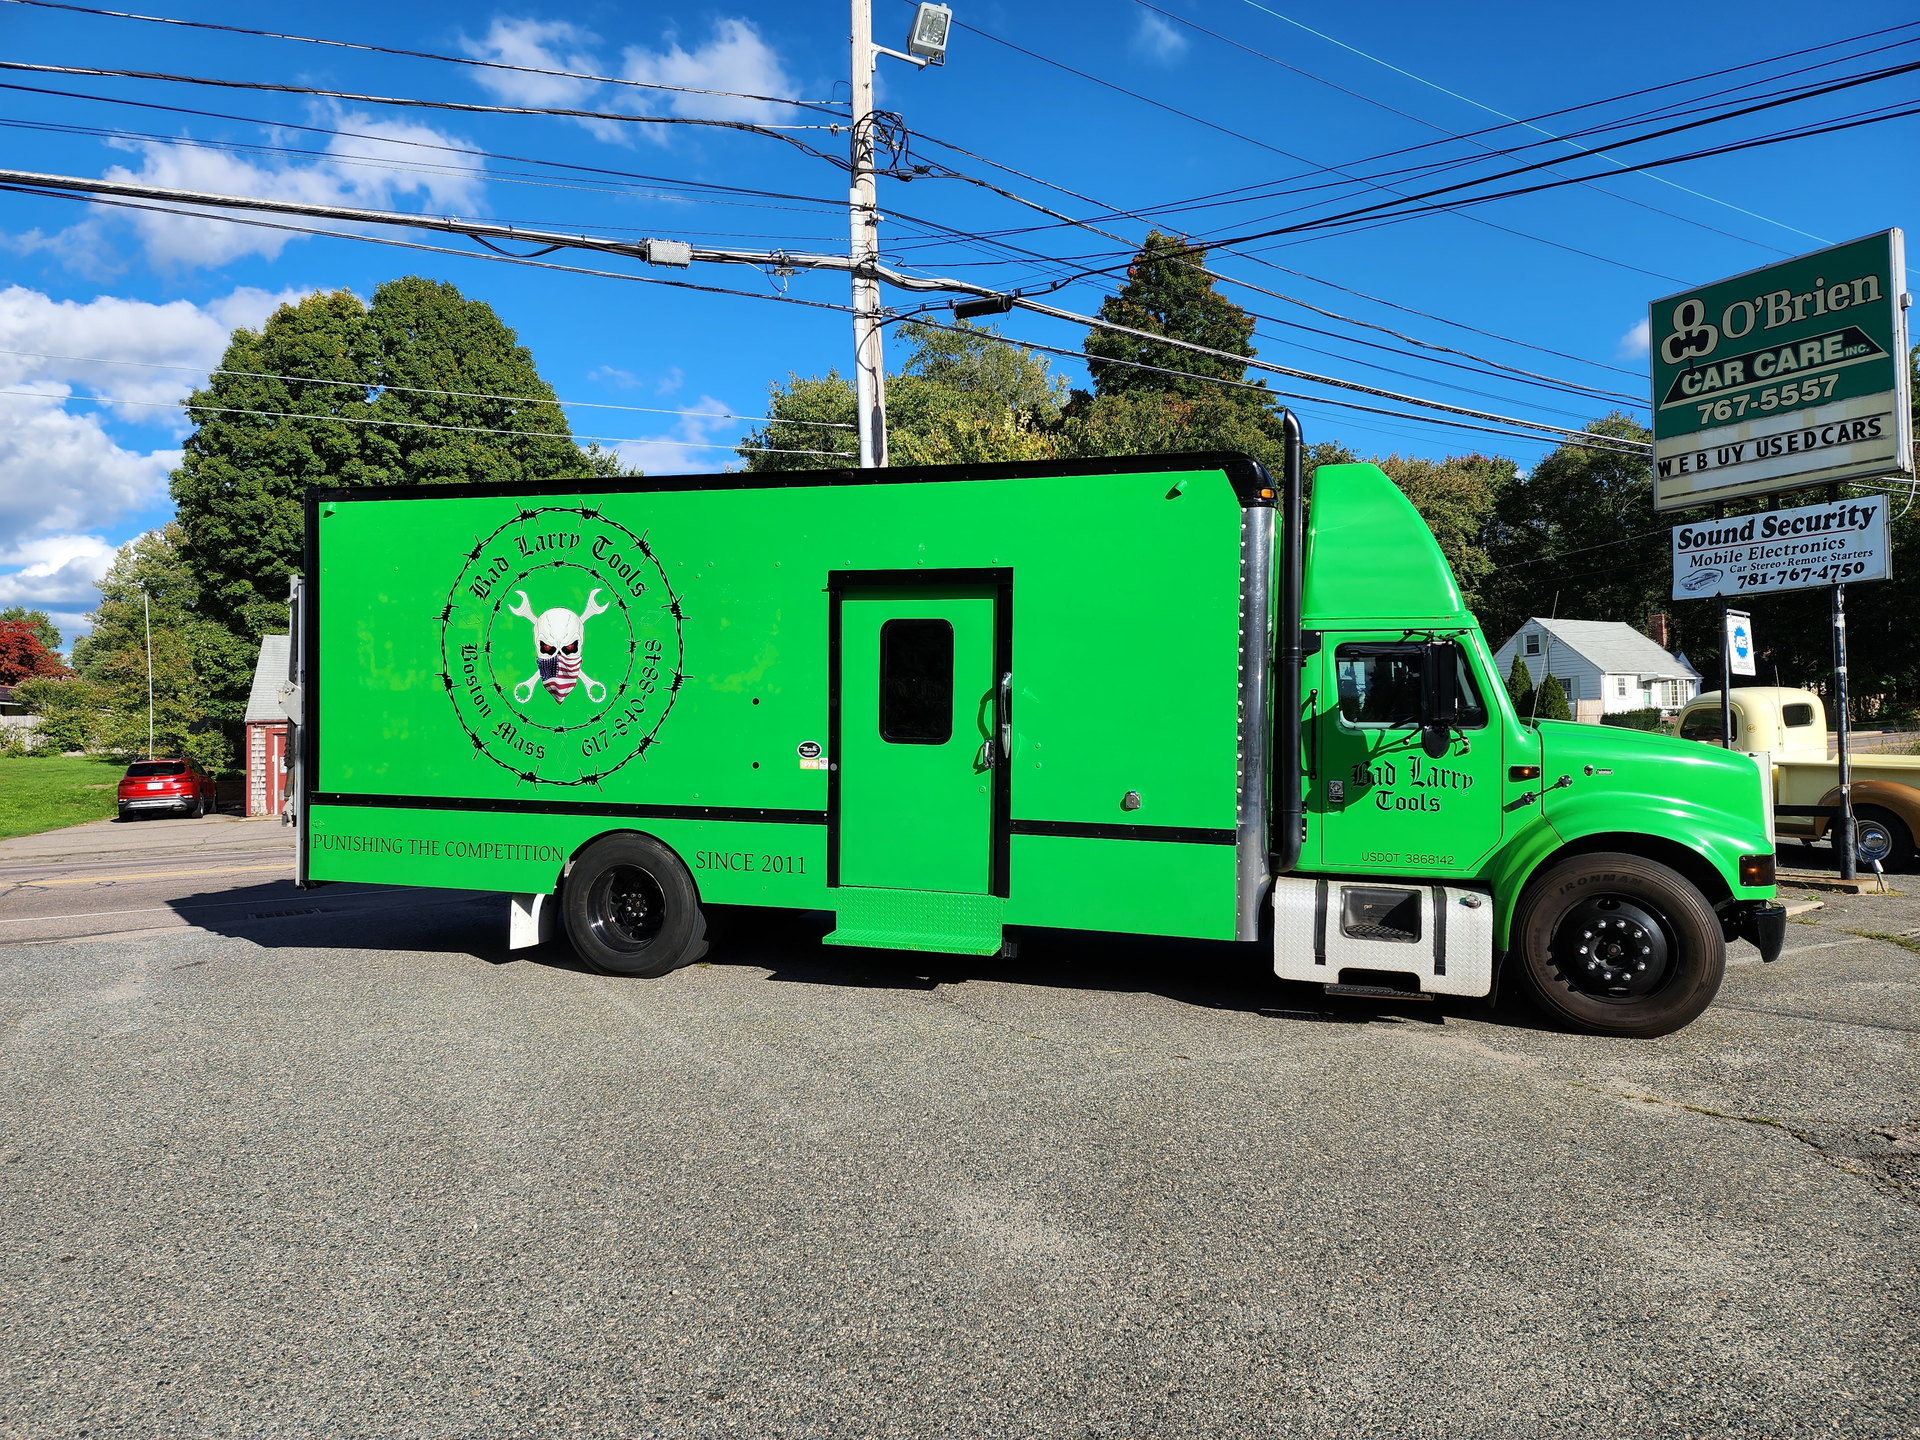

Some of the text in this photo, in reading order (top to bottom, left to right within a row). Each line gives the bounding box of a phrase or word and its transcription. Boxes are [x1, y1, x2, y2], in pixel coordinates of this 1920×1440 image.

[1721, 274, 1883, 340] O'Brien
[1681, 334, 1871, 396] CAR CARE INC.
[1697, 373, 1840, 425] 767-5557
[1677, 504, 1878, 550] Sound Security
[468, 531, 650, 606] Bad Larry Tools
[1689, 537, 1846, 568] Mobile Electronics
[1730, 549, 1874, 574] Car Stereo Remote Starters
[1737, 561, 1866, 590] 781-767-4750
[460, 642, 547, 760] Boston Mass
[580, 638, 663, 759] 617-840-8848
[1350, 755, 1474, 796] Bad Larry
[1375, 790, 1442, 813] Tools
[312, 833, 565, 862] PUNISHING THE COMPETITION
[695, 850, 807, 875] SINCE 2011
[1361, 851, 1455, 866] USDOT 3868142
[1558, 873, 1643, 895] IRONMAN
